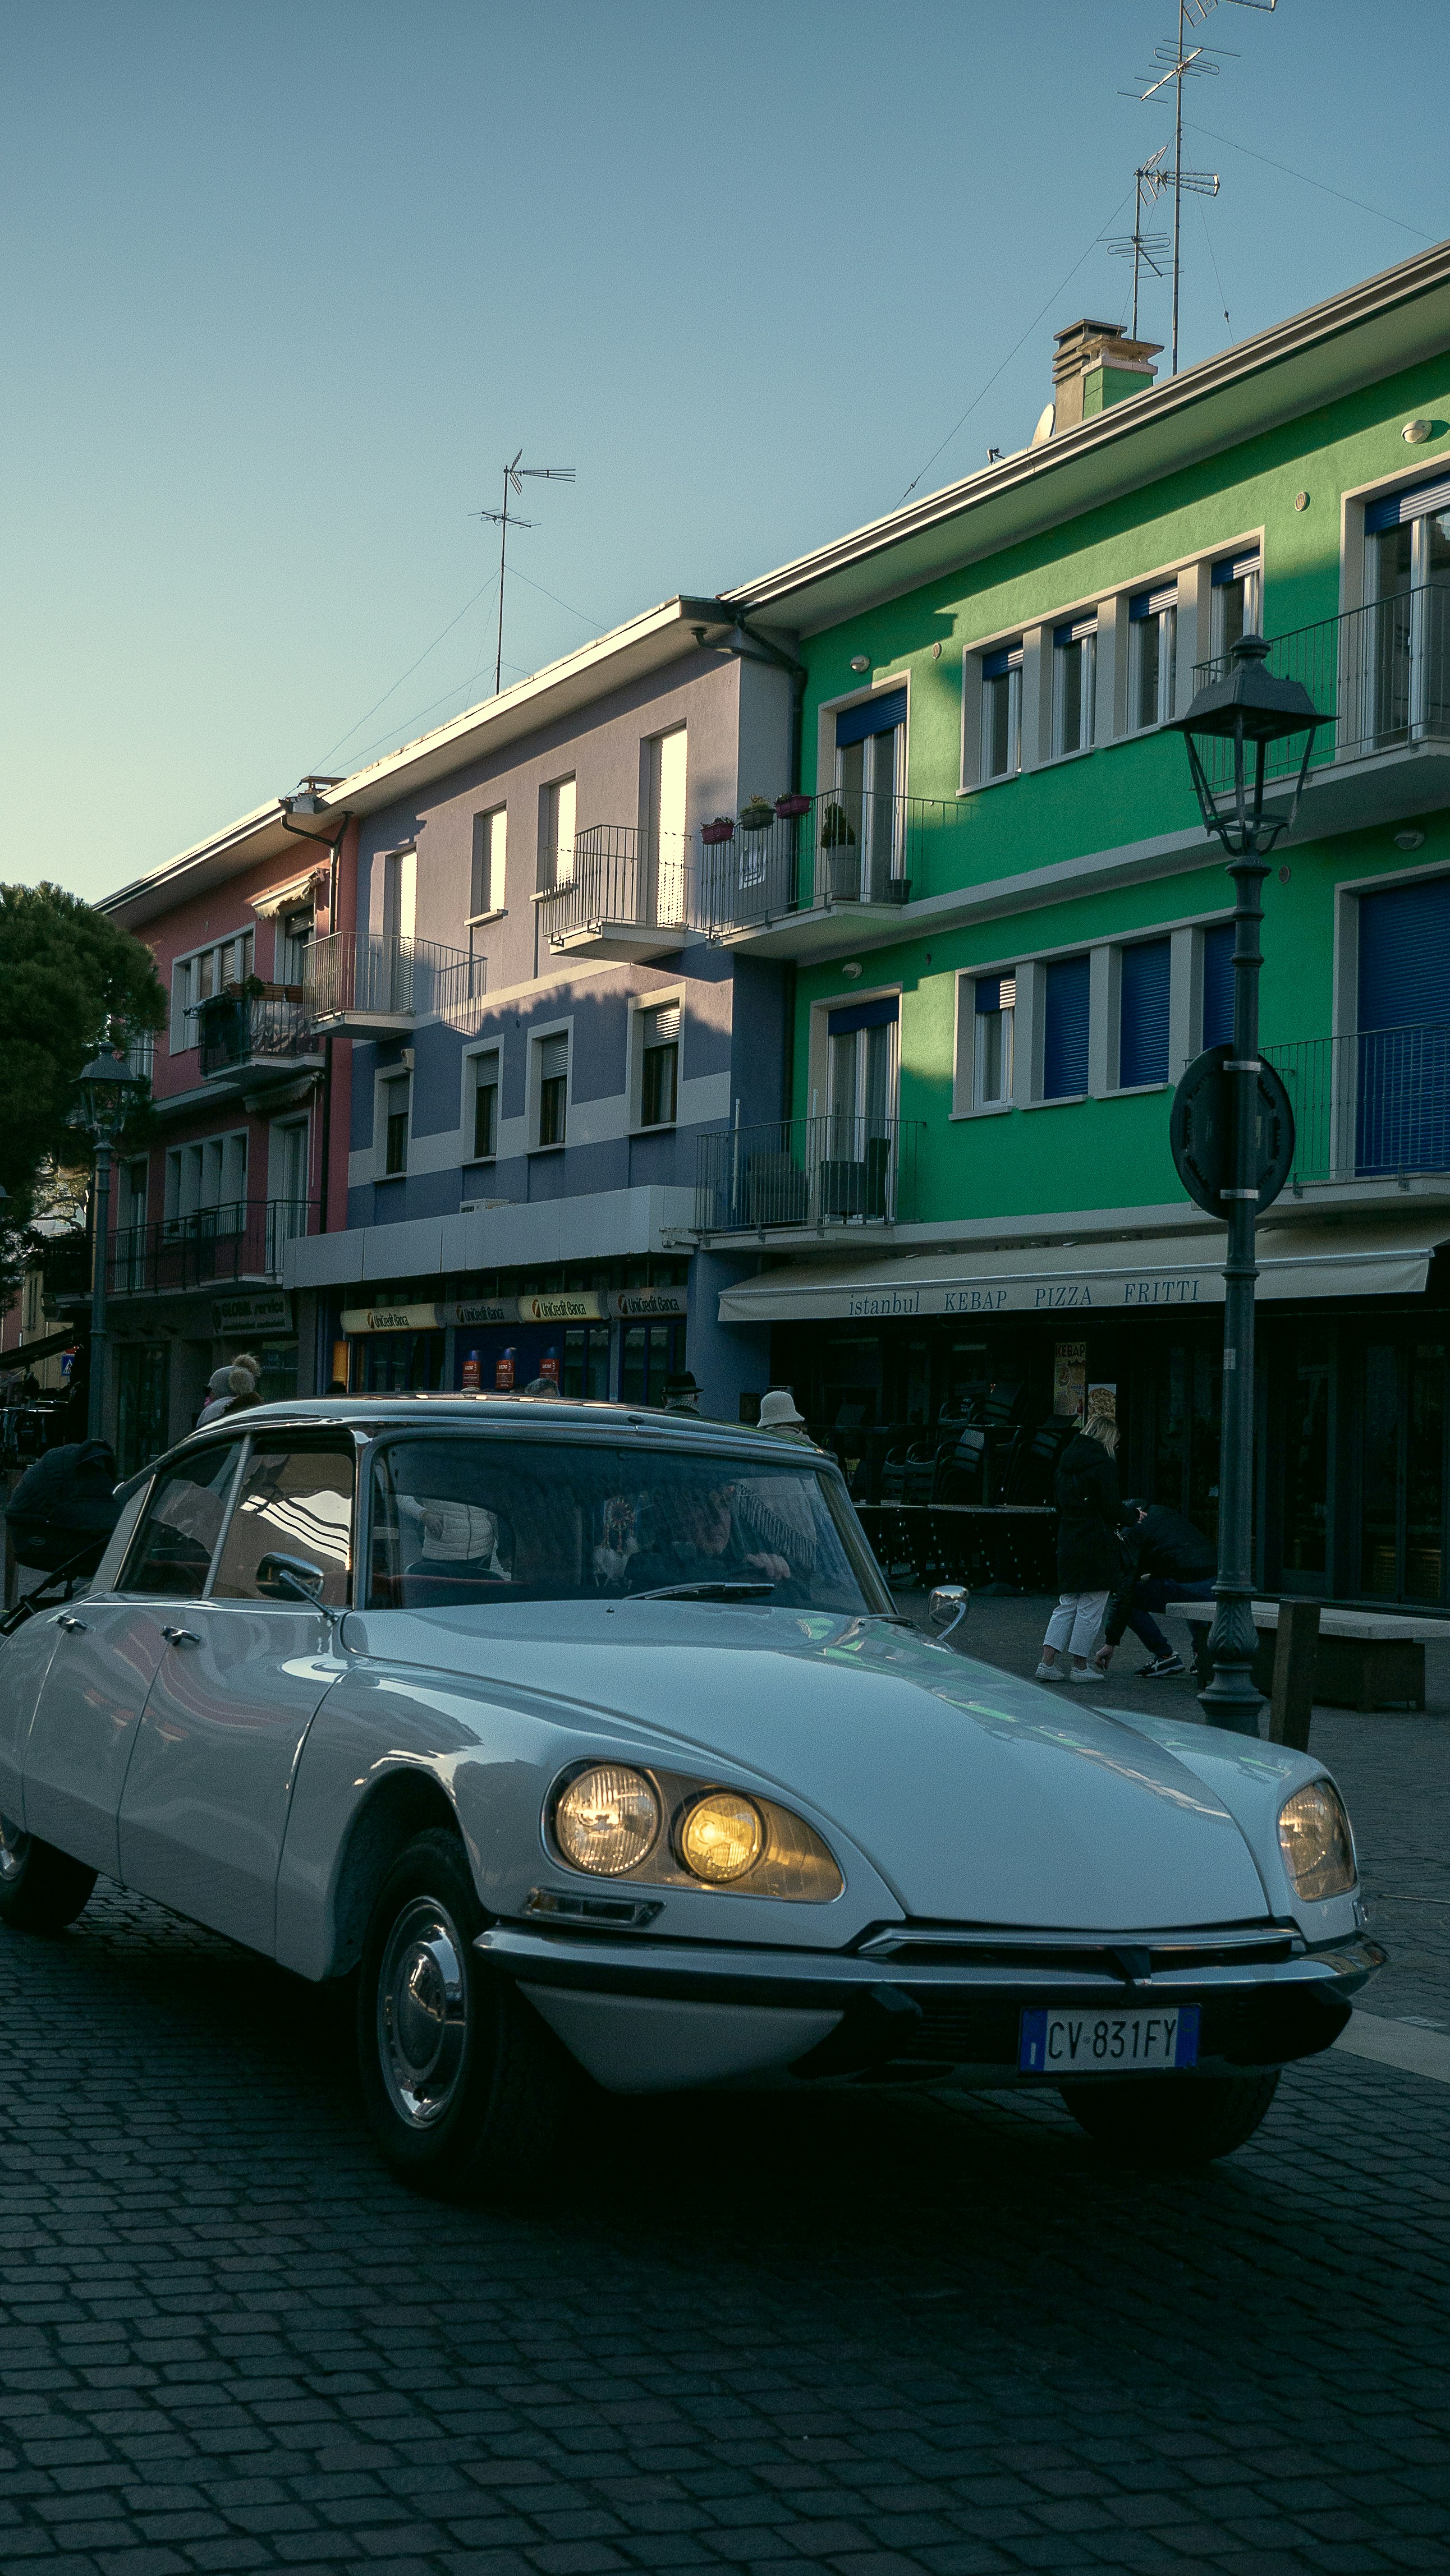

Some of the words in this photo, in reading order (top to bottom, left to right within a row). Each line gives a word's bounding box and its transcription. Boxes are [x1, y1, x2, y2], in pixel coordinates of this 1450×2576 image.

[628, 1295, 658, 1313] UniCredit
[658, 1296, 680, 1312] Banca
[848, 1291, 920, 1315] istanbul
[944, 1291, 1007, 1312] KEBAP
[1034, 1286, 1093, 1308] PIZZA
[1123, 1280, 1200, 1303] FRITTI
[464, 1307, 487, 1322] UniCredit
[487, 1307, 504, 1319] Banca
[541, 1300, 567, 1317] UniCredit
[567, 1301, 587, 1315] Banca
[374, 1313, 393, 1328] UniCredit
[393, 1314, 409, 1327] Banca
[1054, 1344, 1086, 1358] KEBAP
[1048, 2021, 1083, 2059] CV
